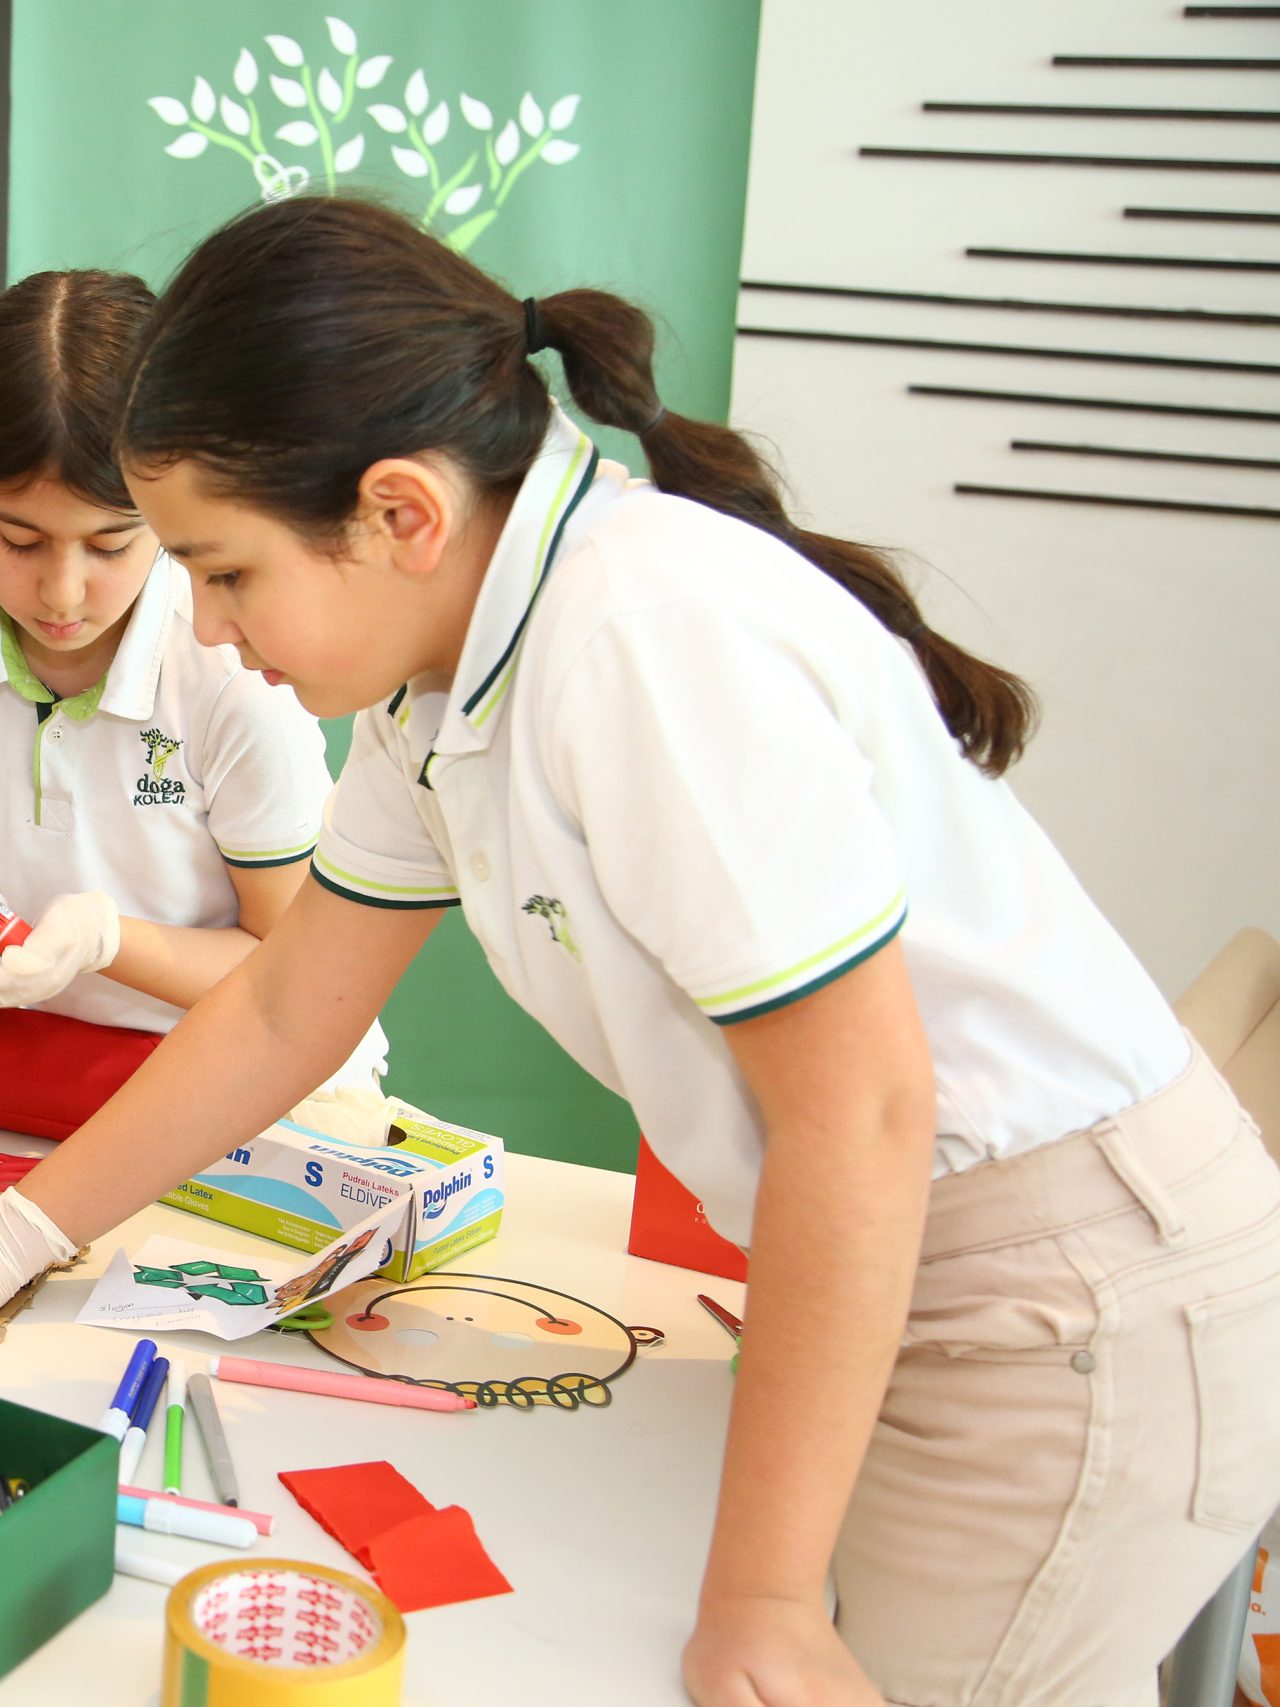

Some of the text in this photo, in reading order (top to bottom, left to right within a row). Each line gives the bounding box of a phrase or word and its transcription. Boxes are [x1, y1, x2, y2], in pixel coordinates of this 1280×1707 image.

[136, 773, 186, 796] doğa
[308, 1144, 416, 1178] Dolphin
[483, 1155, 495, 1179] S
[304, 1161, 324, 1187] S
[190, 1185, 214, 1200] Latex
[340, 1183, 392, 1209] ELDİVE
[371, 1180, 400, 1197] Lateks
[422, 1172, 472, 1209] Dolphin
[184, 1195, 209, 1211] Gloves
